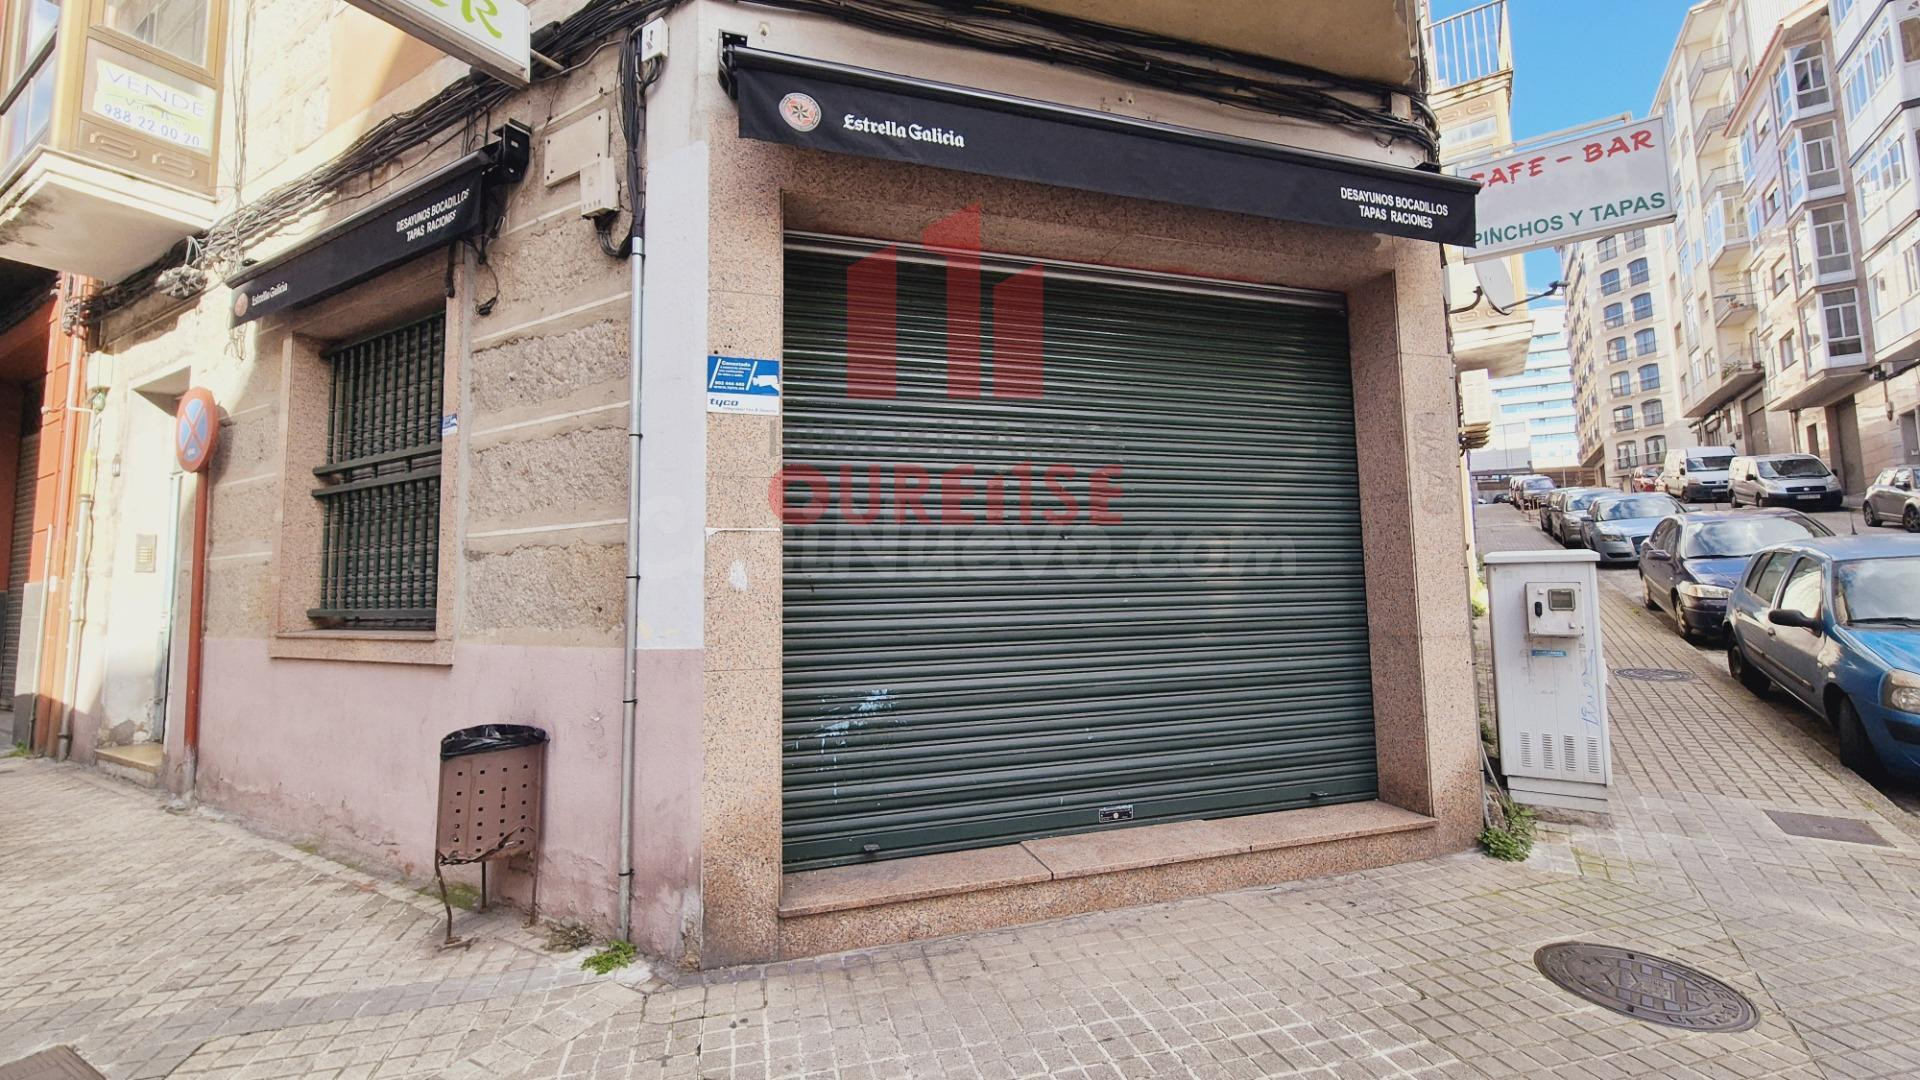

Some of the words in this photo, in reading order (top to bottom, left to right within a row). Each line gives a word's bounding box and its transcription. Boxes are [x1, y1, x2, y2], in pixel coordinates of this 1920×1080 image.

[106, 68, 205, 117] VENDE
[104, 103, 131, 122] 988
[139, 117, 155, 132] 22
[161, 125, 178, 140] 00
[843, 113, 907, 138] Estrella
[908, 124, 965, 148] Galicia
[1583, 130, 1656, 163] BAR
[396, 207, 431, 232] DESAYUNOS
[431, 188, 470, 216] BOCADILLOS
[1340, 187, 1394, 206] DESAYUNOS
[1395, 196, 1448, 216] BOCADILLOS
[1359, 205, 1387, 221] TAPAS
[1390, 211, 1433, 229] RACIONES
[406, 224, 425, 242] TAPAS
[426, 209, 456, 233] RACIONES
[1475, 215, 1564, 246] PINCHOS
[1569, 210, 1583, 226] Y
[1589, 192, 1666, 221] TAPAS
[709, 398, 739, 407] tyco
